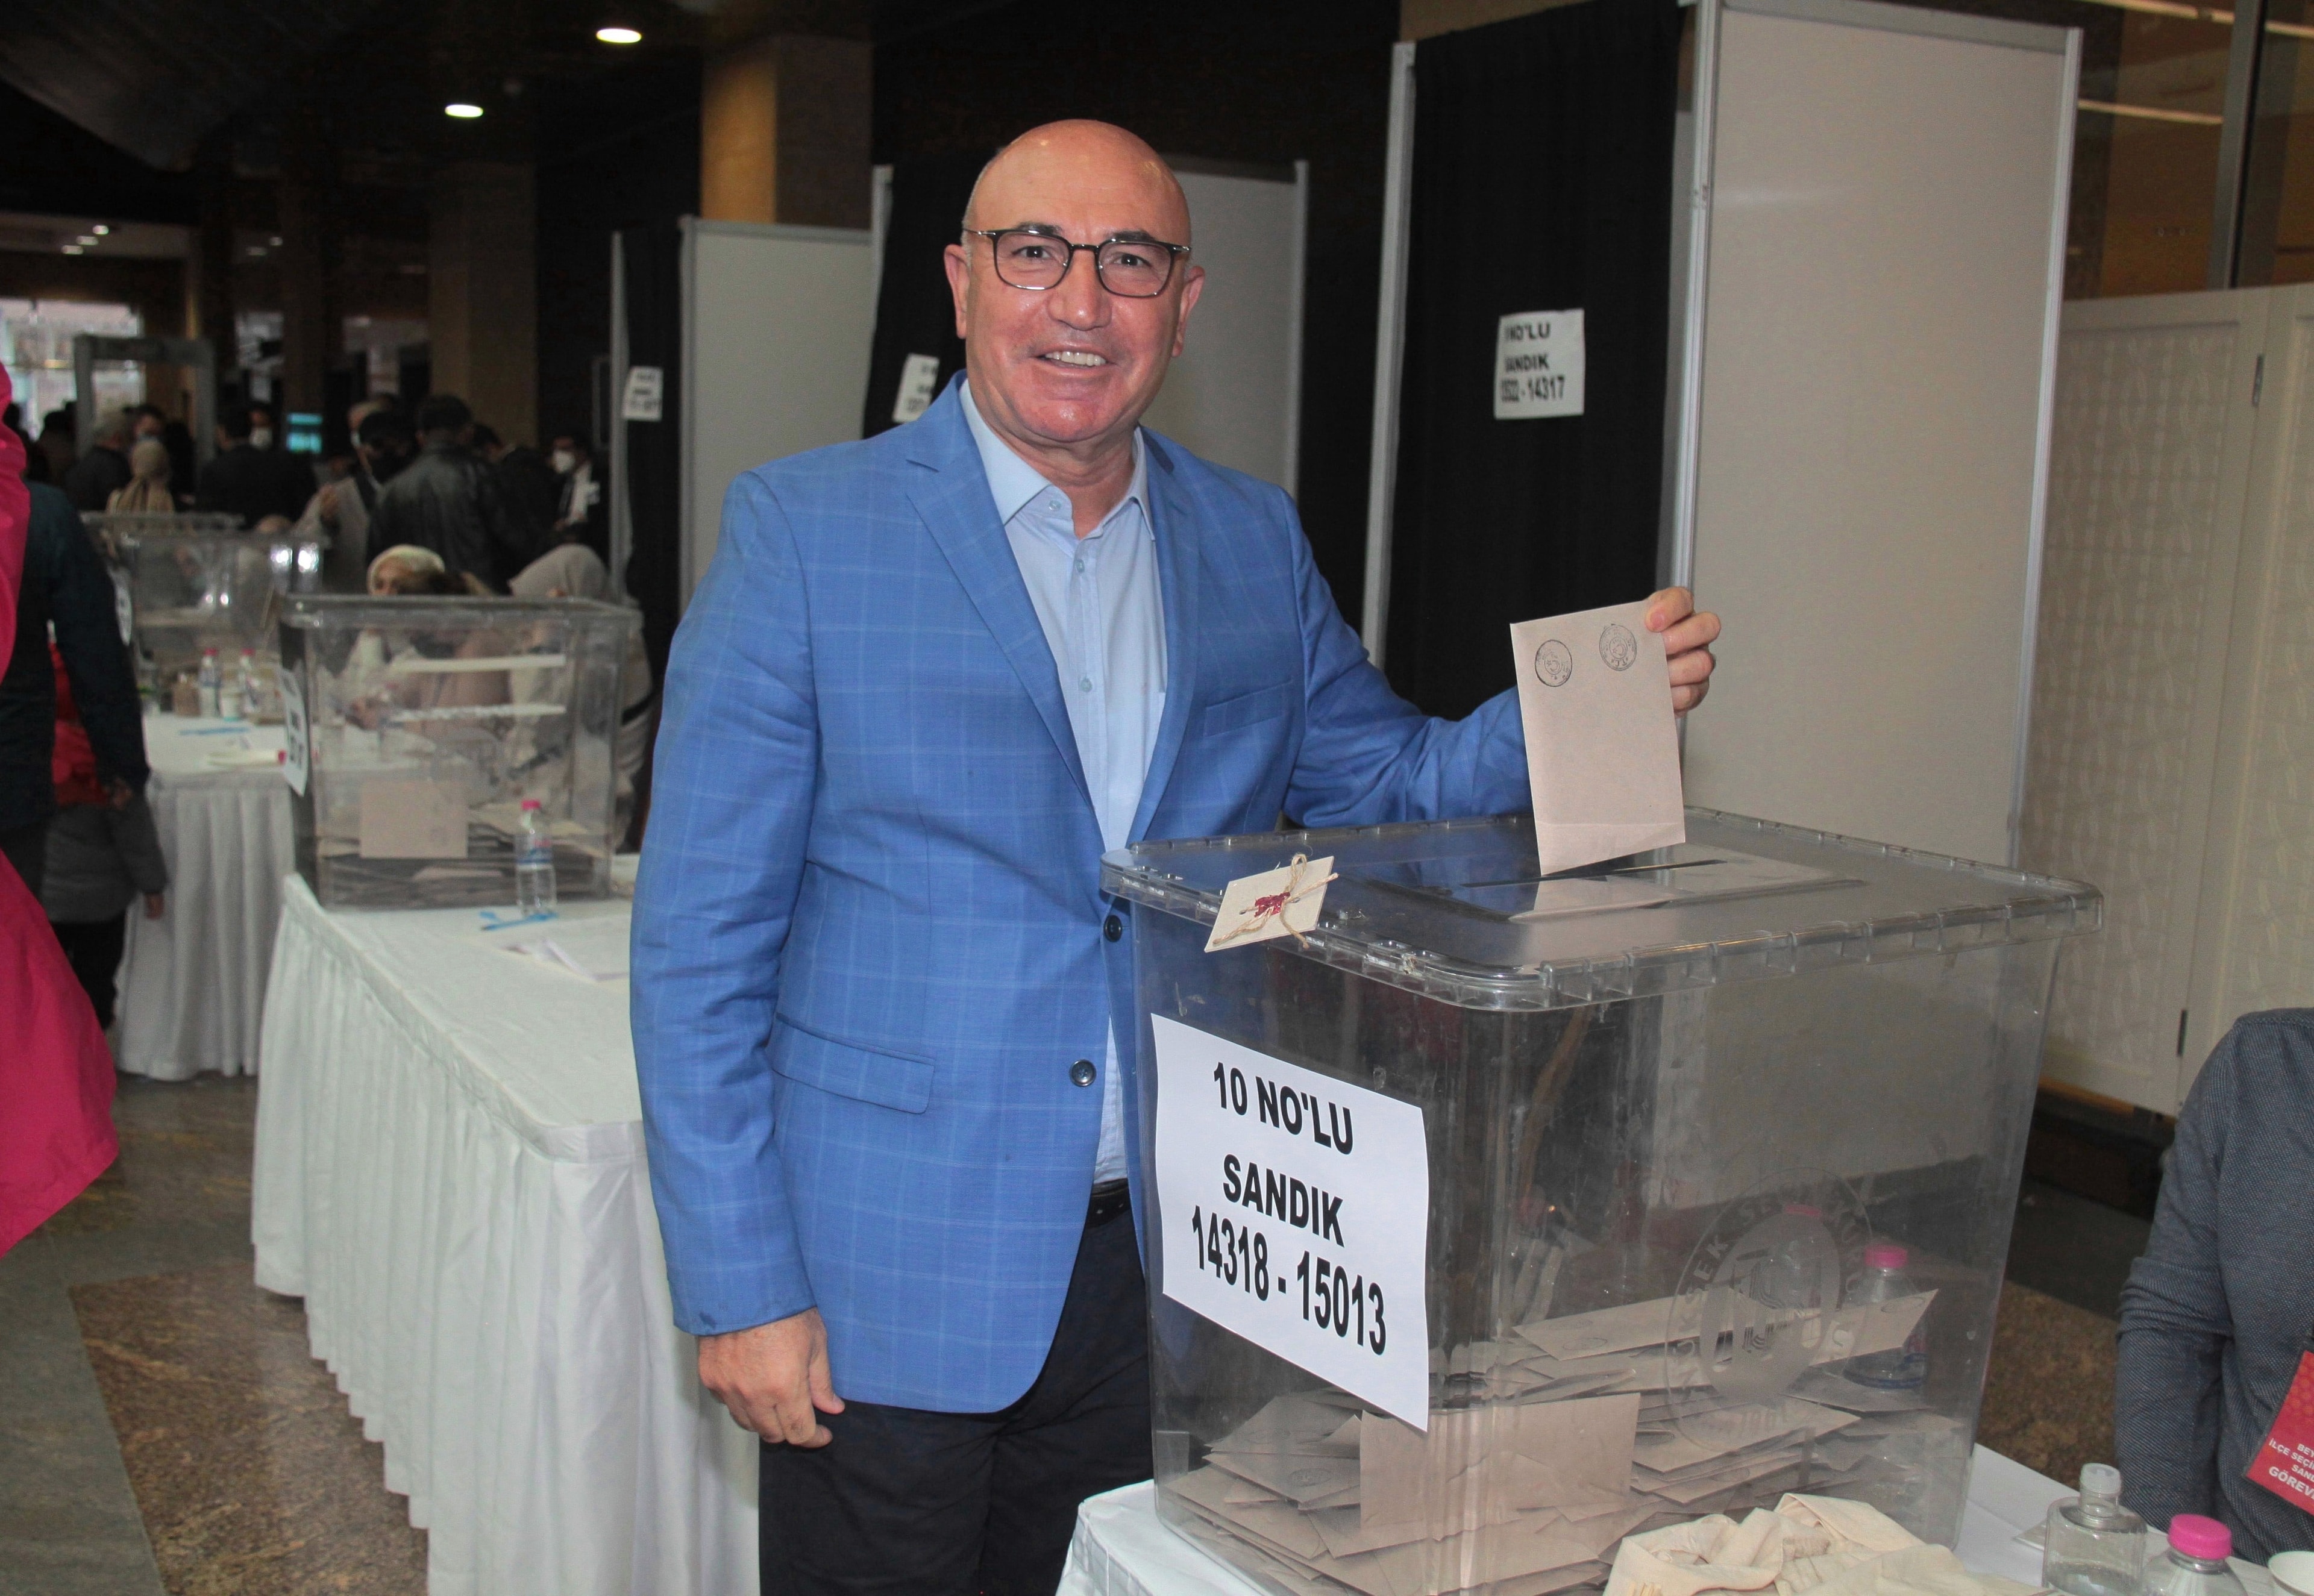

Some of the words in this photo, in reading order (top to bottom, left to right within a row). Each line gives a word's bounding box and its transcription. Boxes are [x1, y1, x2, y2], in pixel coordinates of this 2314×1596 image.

[1214, 1062, 1247, 1116] 10
[1255, 1076, 1353, 1155] NO'LU
[1223, 1154, 1344, 1247] SANDIK
[1192, 1205, 1269, 1301] 14318
[1278, 1277, 1287, 1294] -
[1297, 1251, 1386, 1356] 15013
[2268, 1438, 2290, 1456] İLÇE
